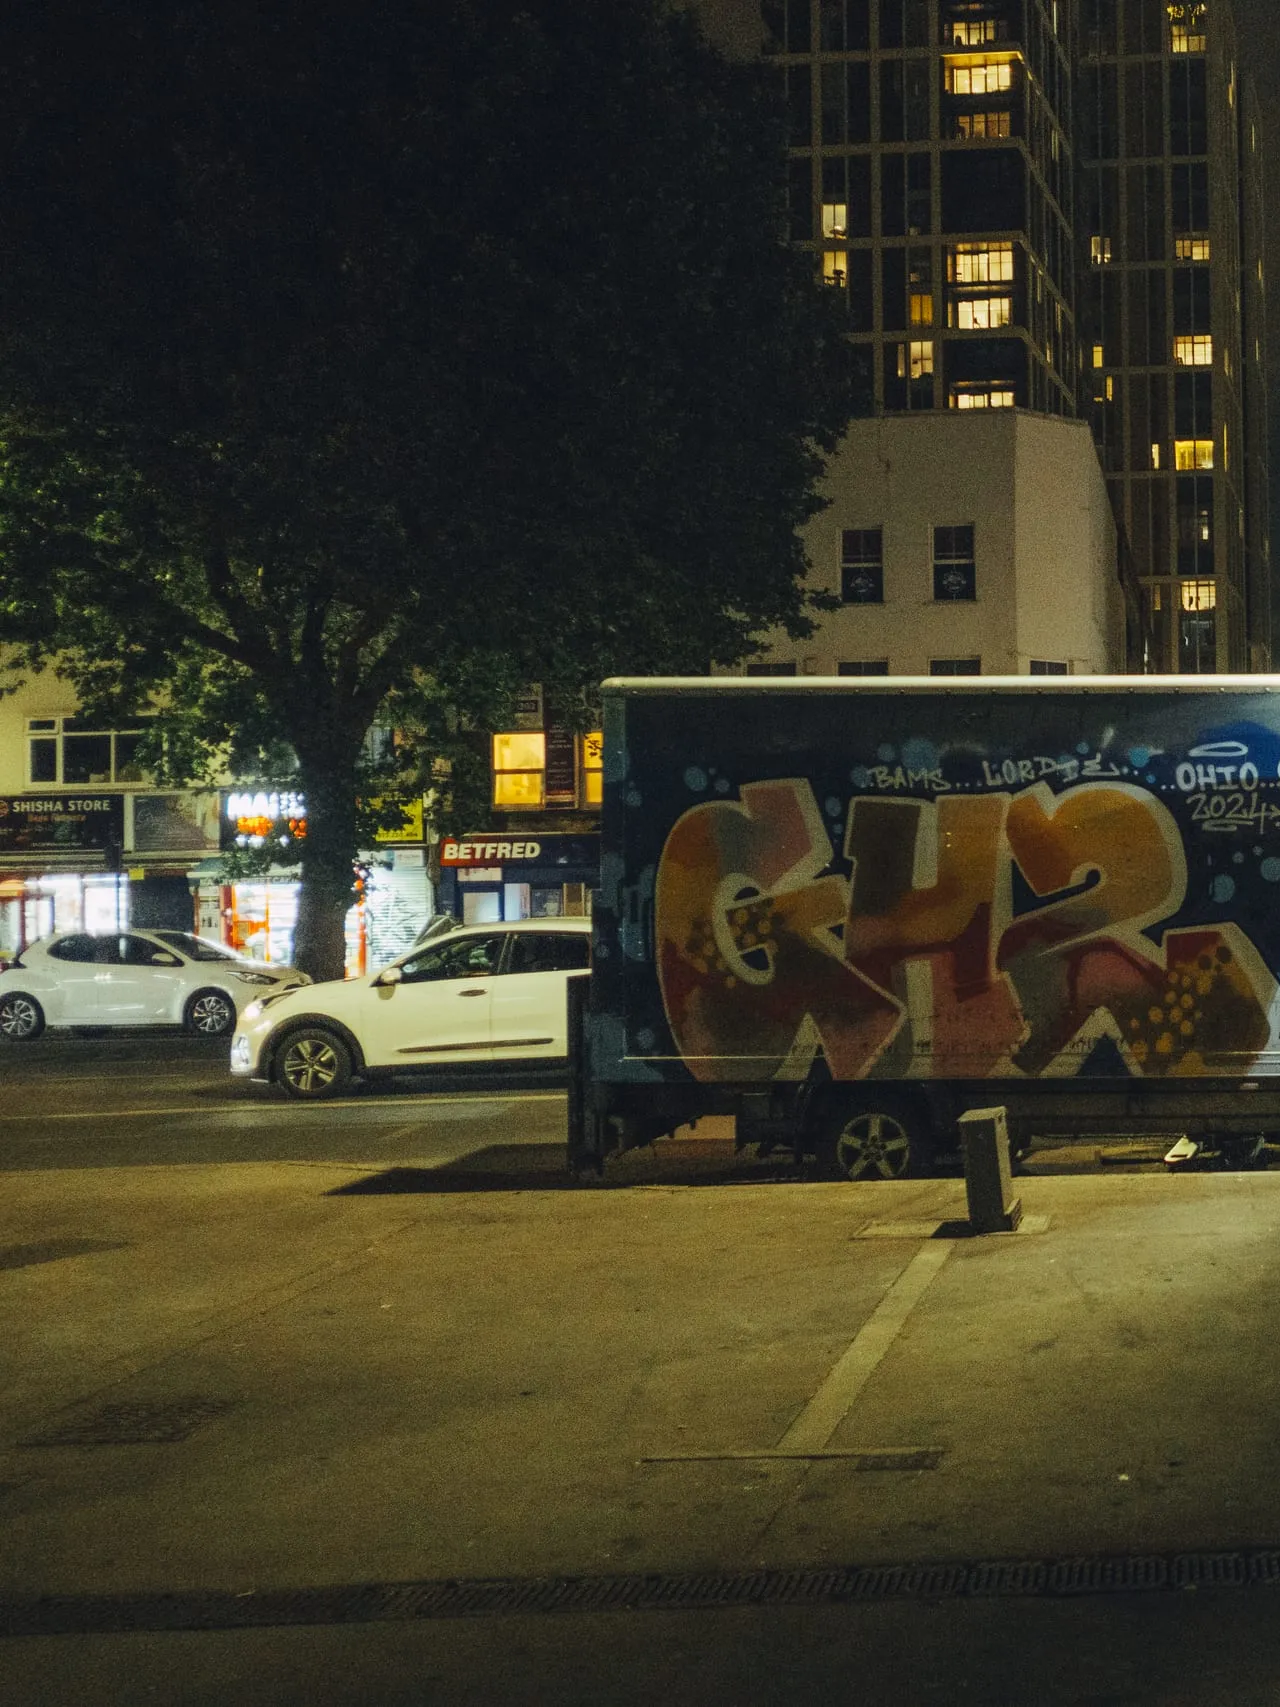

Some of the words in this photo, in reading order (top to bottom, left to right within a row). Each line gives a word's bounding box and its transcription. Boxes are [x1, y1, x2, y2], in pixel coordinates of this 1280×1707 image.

[12, 800, 64, 812] SHISHA
[68, 799, 111, 812] STORE
[443, 842, 541, 860] BETFRED
